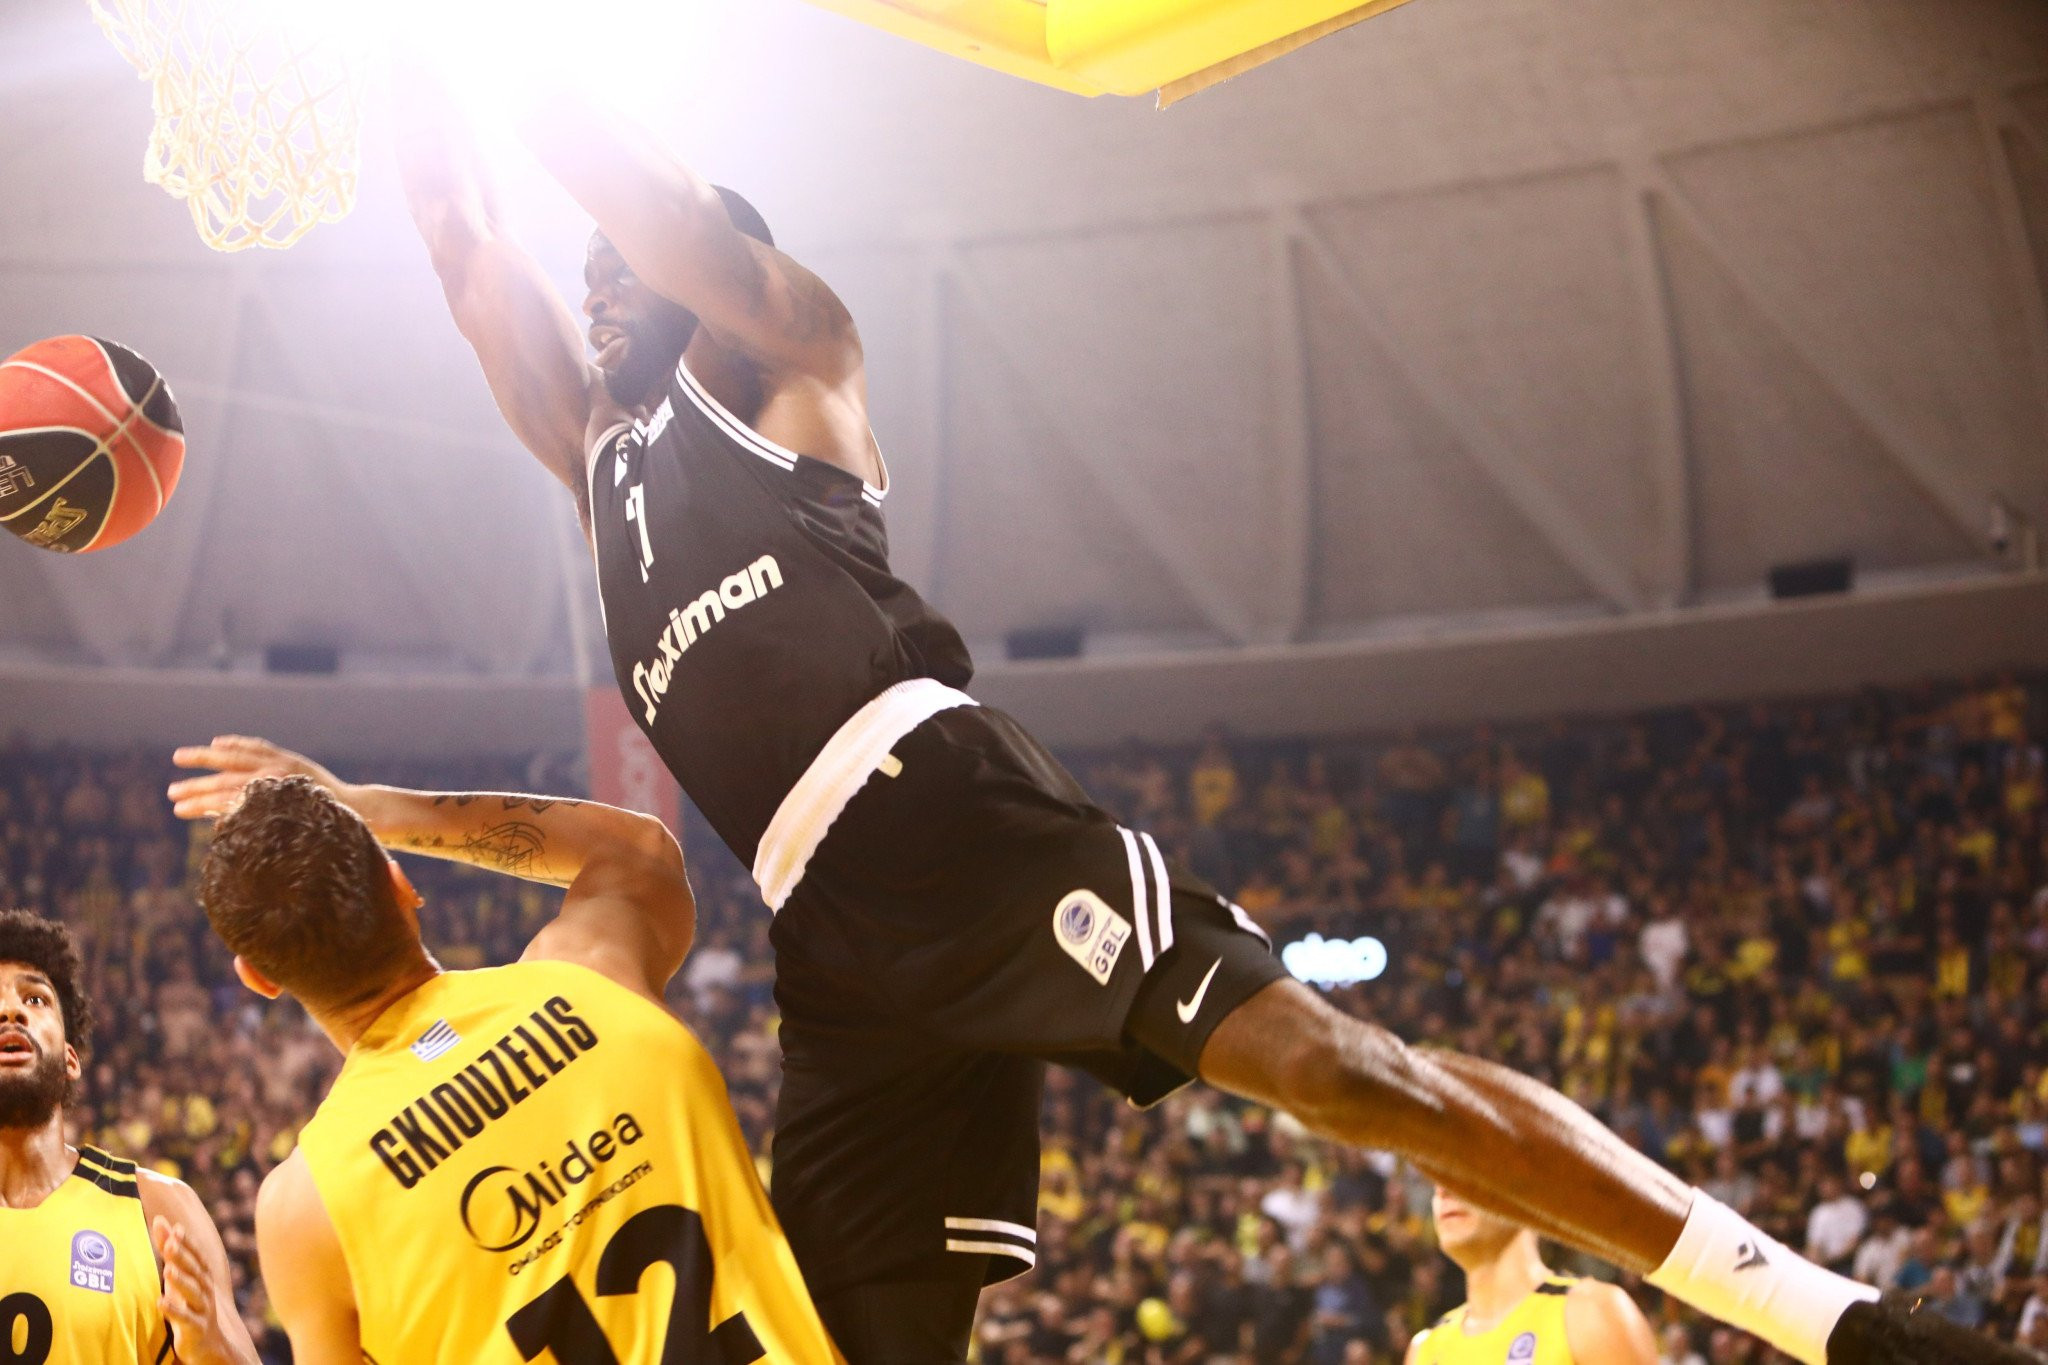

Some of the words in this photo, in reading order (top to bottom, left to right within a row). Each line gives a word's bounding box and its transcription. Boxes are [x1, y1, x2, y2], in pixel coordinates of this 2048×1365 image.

[1095, 930, 1126, 975] GBL
[369, 995, 599, 1190] GKIOUZELIS
[503, 1112, 644, 1240] Midea
[73, 1270, 111, 1291] GBL
[505, 1204, 767, 1365] 12
